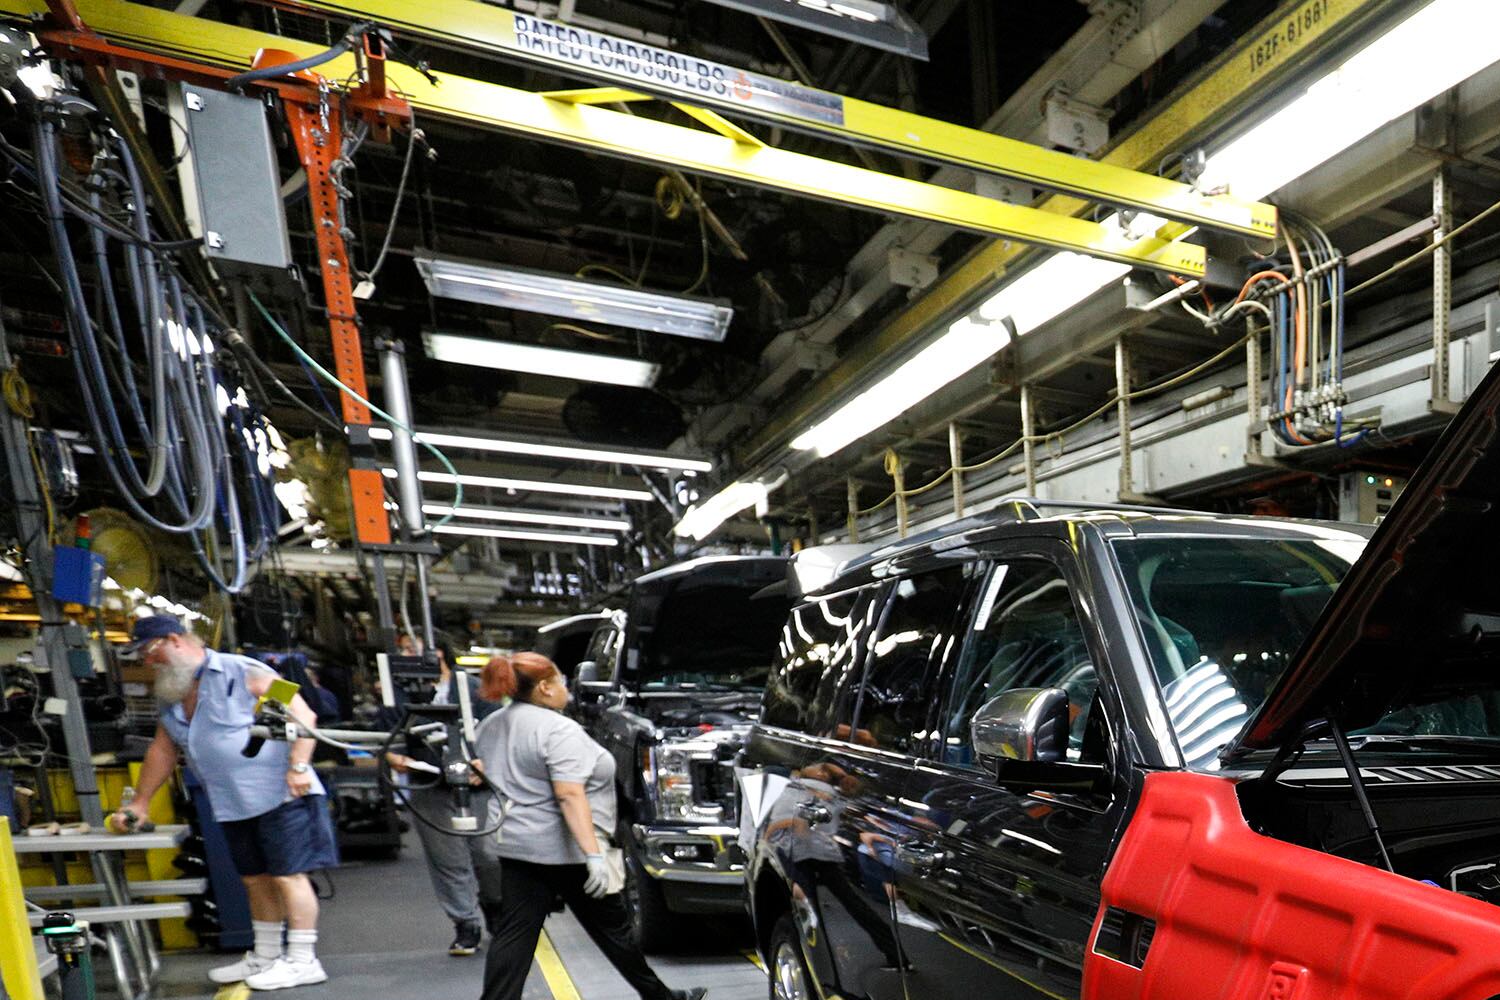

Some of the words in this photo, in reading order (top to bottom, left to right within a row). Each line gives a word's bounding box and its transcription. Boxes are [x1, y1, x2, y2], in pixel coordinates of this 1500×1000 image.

[515, 15, 582, 60] RATED
[587, 33, 640, 75] LOAD
[641, 48, 680, 84] 350
[682, 57, 732, 98] LBS.
